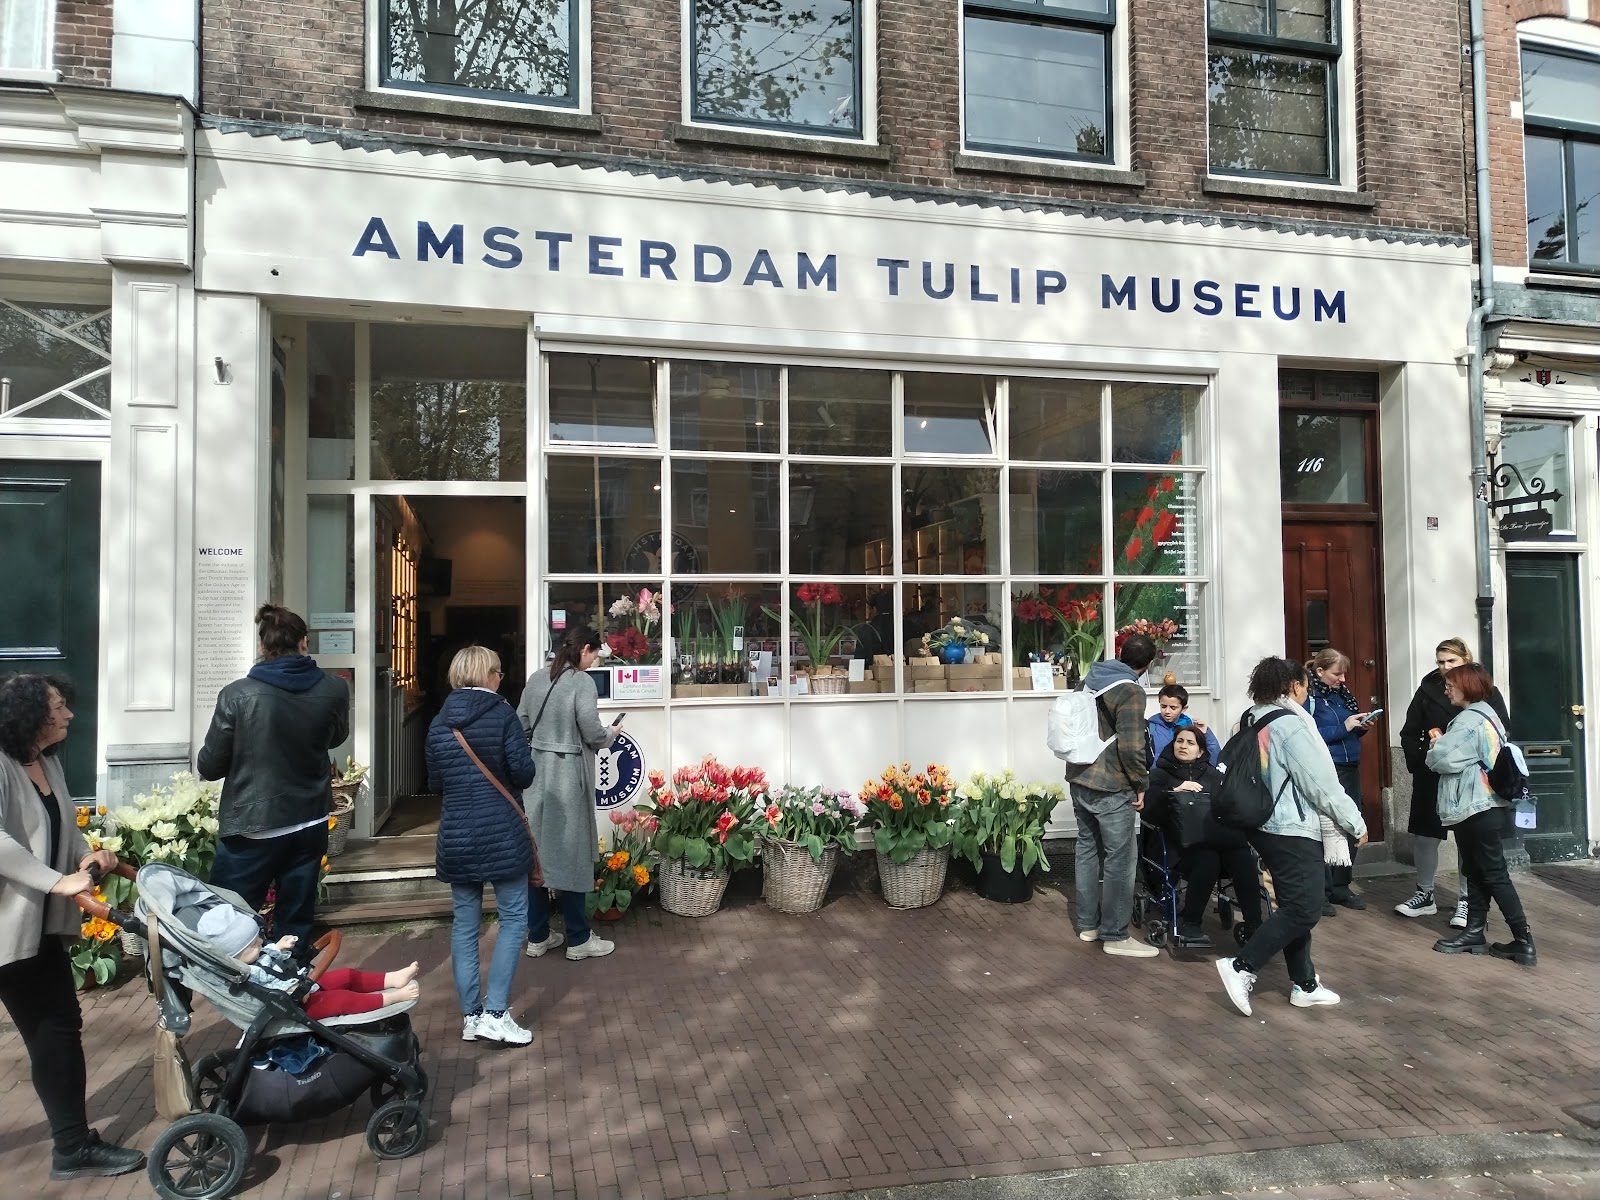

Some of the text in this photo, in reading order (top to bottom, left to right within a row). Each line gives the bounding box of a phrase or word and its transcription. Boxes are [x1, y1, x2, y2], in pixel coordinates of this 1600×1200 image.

[352, 216, 1347, 323] AMSTERDAM TULIP MUSEUM
[1297, 457, 1325, 473] 116
[199, 548, 243, 556] WELCOME
[630, 534, 695, 560] AMSTDAM
[601, 768, 641, 805] MUSEUM
